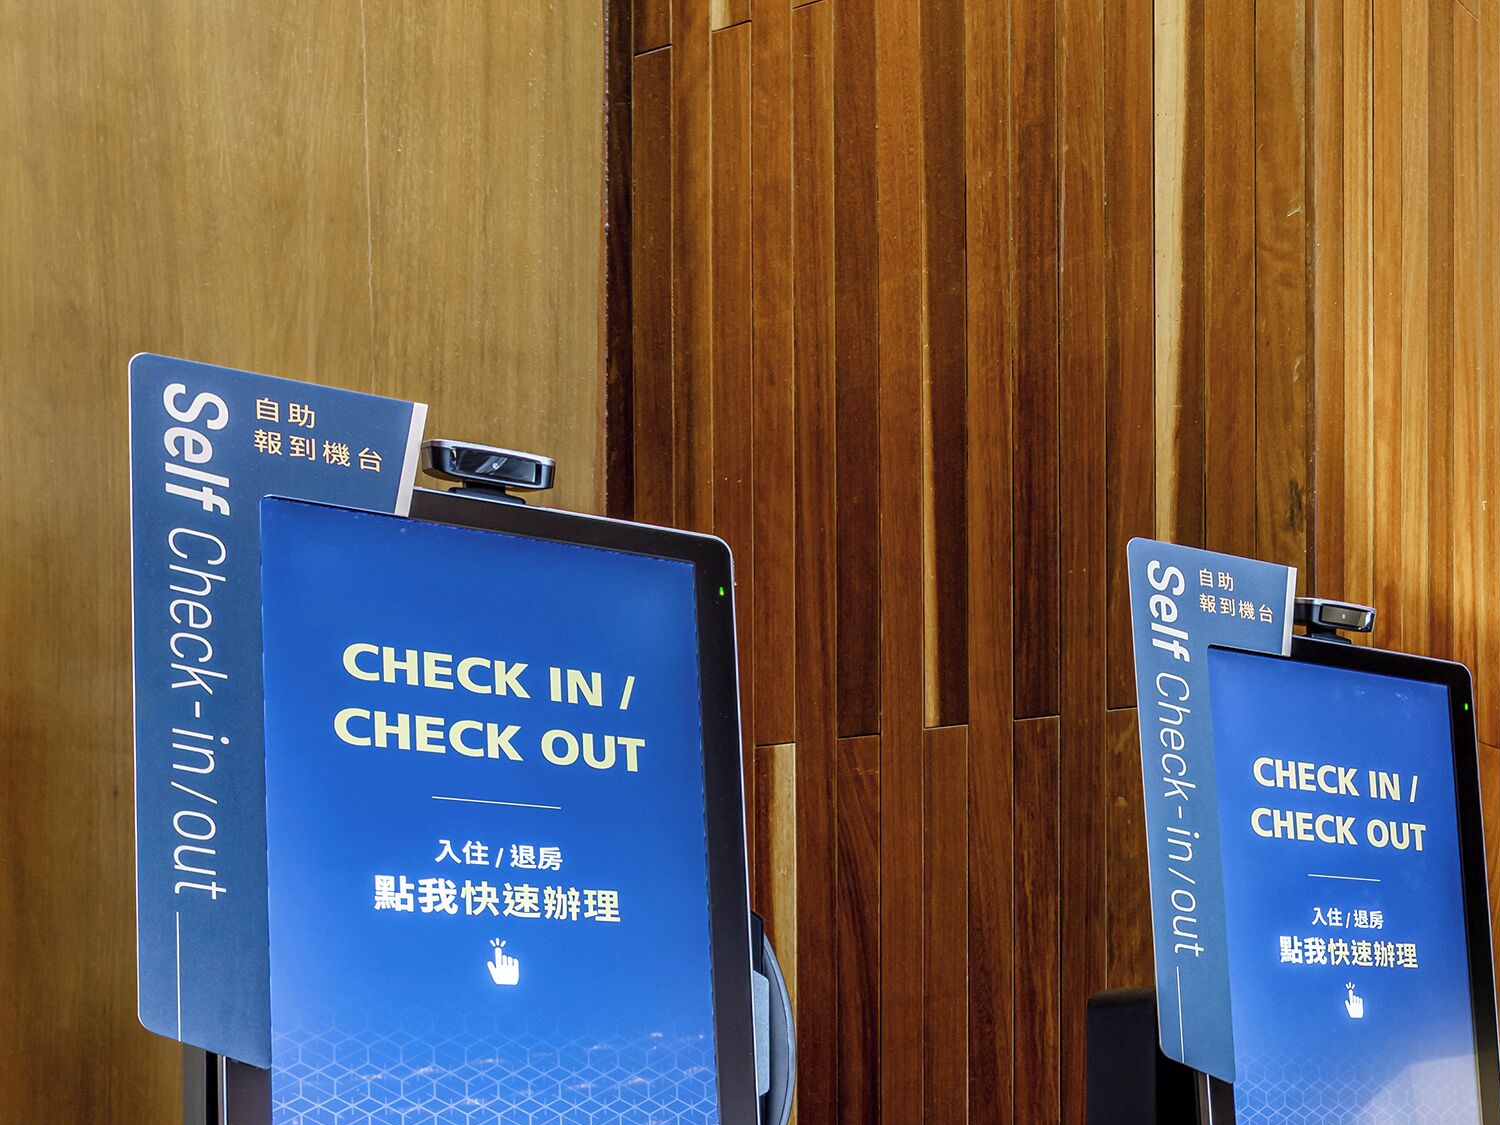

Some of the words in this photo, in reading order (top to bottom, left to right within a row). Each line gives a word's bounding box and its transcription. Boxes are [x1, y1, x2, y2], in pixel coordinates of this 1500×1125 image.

[256, 398, 316, 429] 自助
[162, 383, 231, 516] Self
[253, 430, 383, 472] 報到機台
[1199, 568, 1234, 591] 自助
[1147, 560, 1191, 663] Self
[1200, 593, 1275, 624] 報到機台
[341, 643, 530, 698] CHECK
[548, 667, 602, 709] IN
[333, 708, 524, 762] CHECK
[540, 729, 647, 773] OUT
[1252, 757, 1357, 797] CHECK
[1369, 771, 1401, 801] IN
[1250, 807, 1358, 846] CHECK
[1366, 819, 1427, 852] OUT
[374, 874, 620, 923] 點我快速辦理
[1279, 935, 1418, 969] 點我快速辦理
